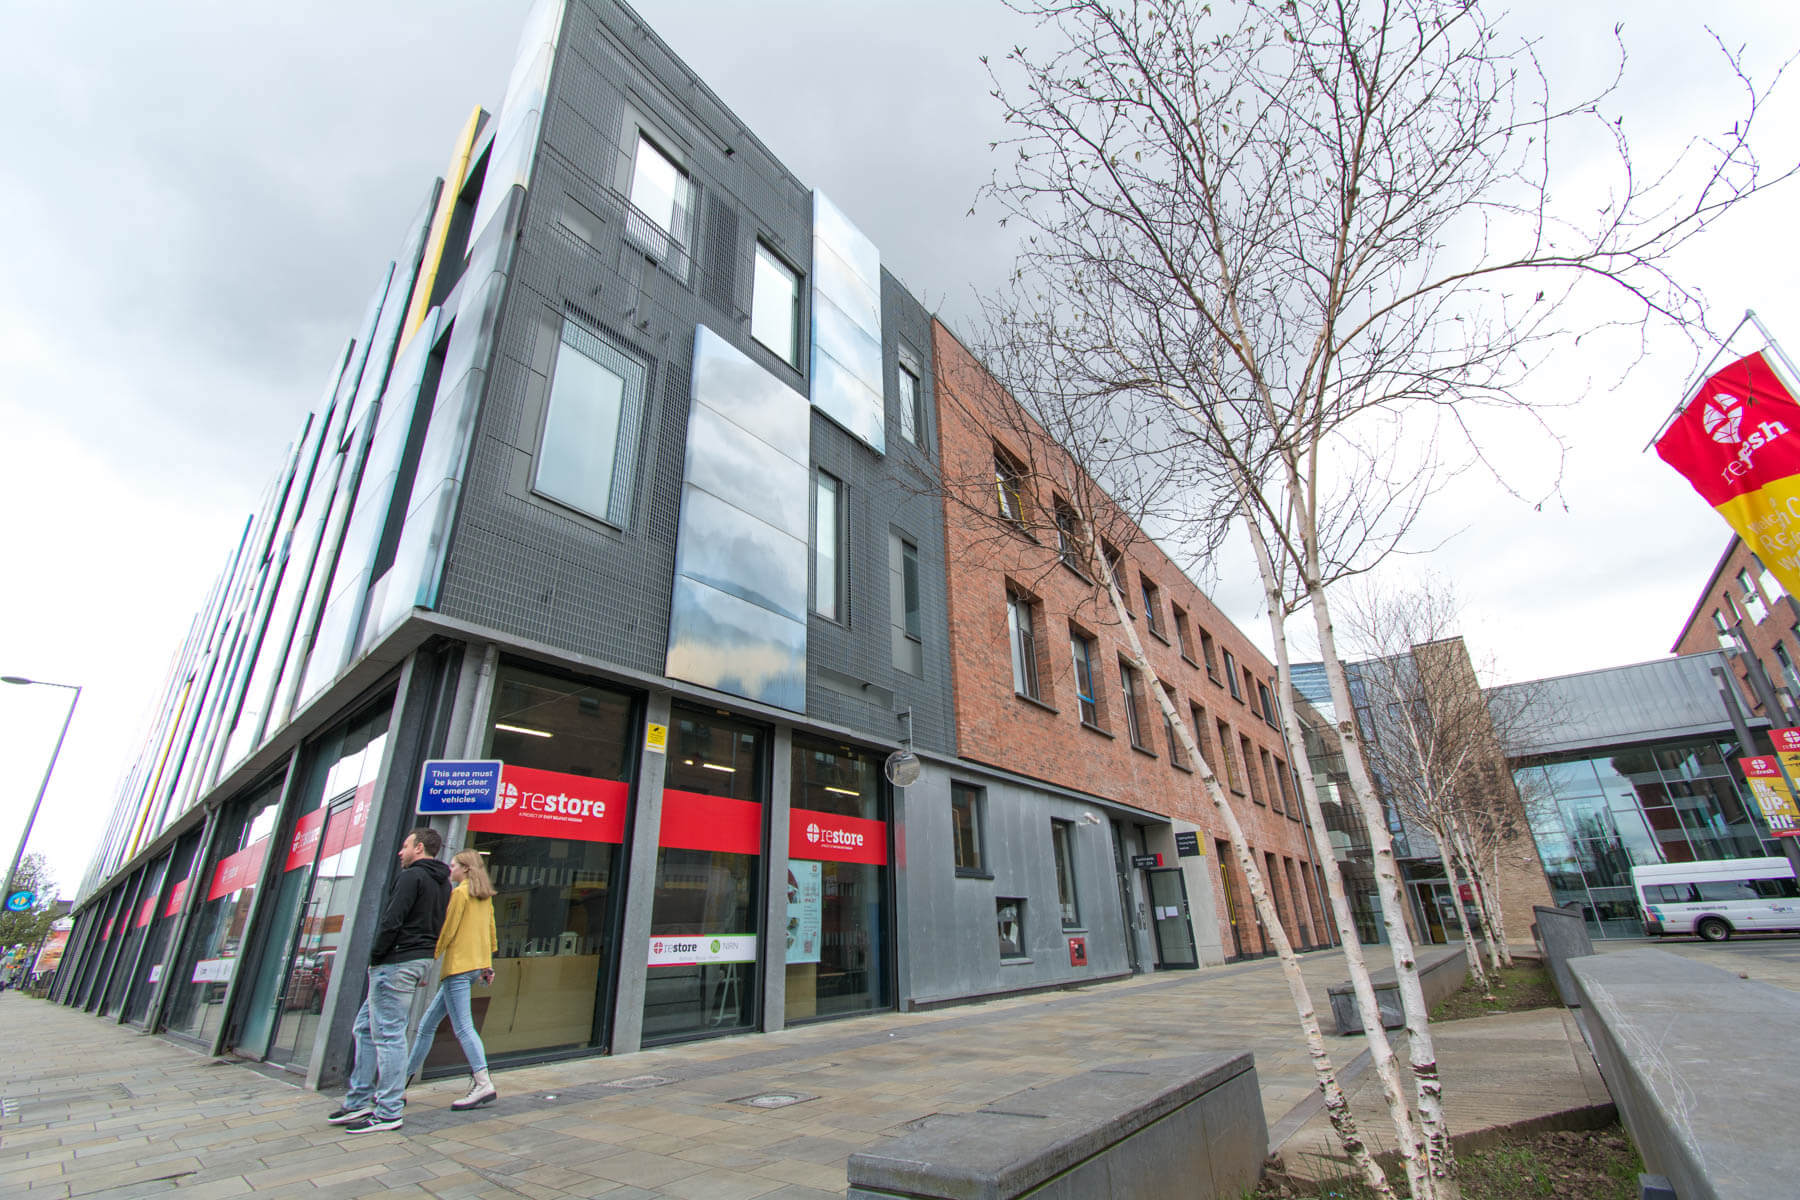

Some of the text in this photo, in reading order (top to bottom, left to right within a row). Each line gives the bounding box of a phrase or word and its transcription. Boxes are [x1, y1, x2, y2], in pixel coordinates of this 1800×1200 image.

[447, 779, 466, 787] kept
[467, 778, 489, 786] clear
[430, 787, 442, 795] for
[443, 787, 490, 796] emergency
[520, 790, 606, 818] restore
[1767, 815, 1793, 829] HI!
[821, 829, 864, 847] restore
[664, 942, 697, 953] restore
